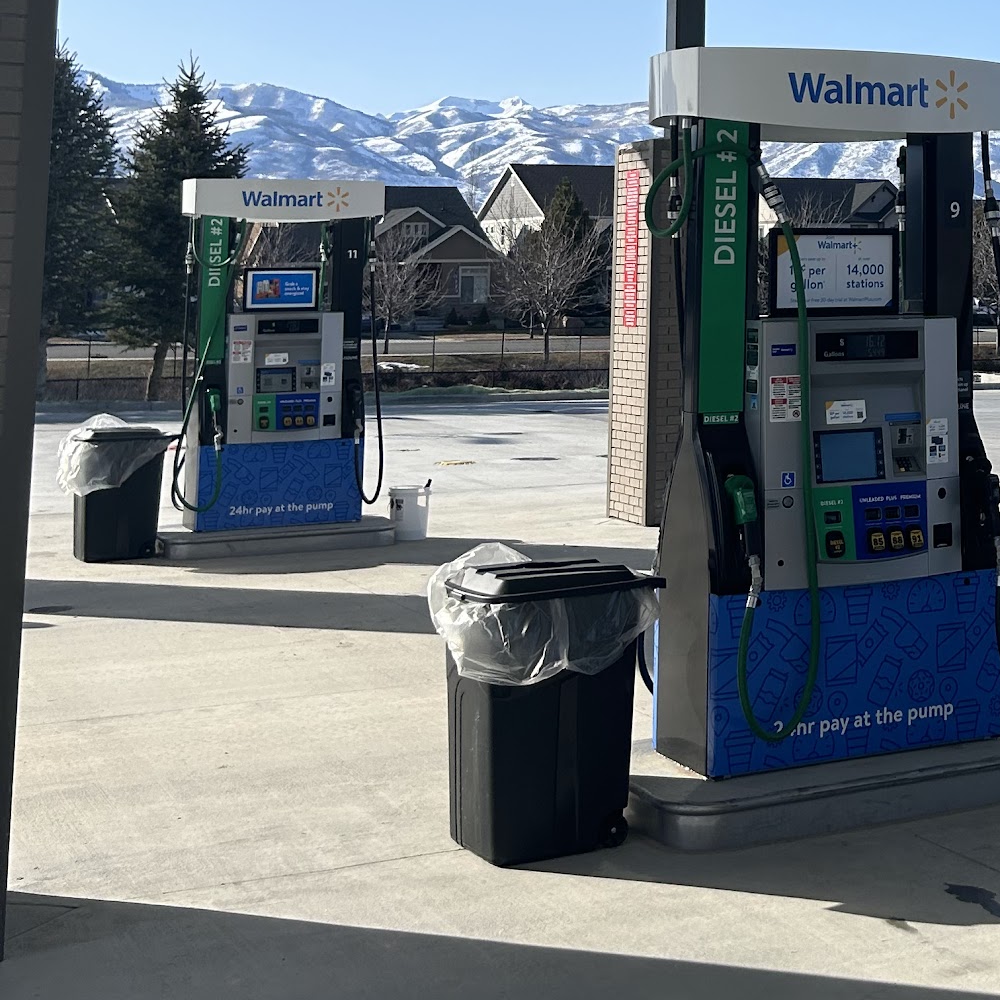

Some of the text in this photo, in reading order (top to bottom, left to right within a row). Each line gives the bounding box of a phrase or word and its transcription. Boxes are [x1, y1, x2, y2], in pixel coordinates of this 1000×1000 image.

[788, 72, 929, 108] Walmart
[242, 189, 323, 208] Walmart
[950, 201, 960, 219] 9
[713, 170, 737, 265] DIESEL
[210, 218, 223, 236] #2
[347, 249, 358, 259] 11
[808, 267, 826, 278] per
[846, 264, 885, 277] 14,000
[790, 279, 825, 293] gllon
[846, 278, 885, 289] stations
[703, 414, 739, 423] DIESEL #2
[859, 496, 884, 504] UNLEADED
[229, 501, 334, 517] 24hr pay at the pump
[872, 537, 884, 546] 85
[911, 535, 922, 544] 91
[773, 702, 954, 738] 2hr pay at the pump
